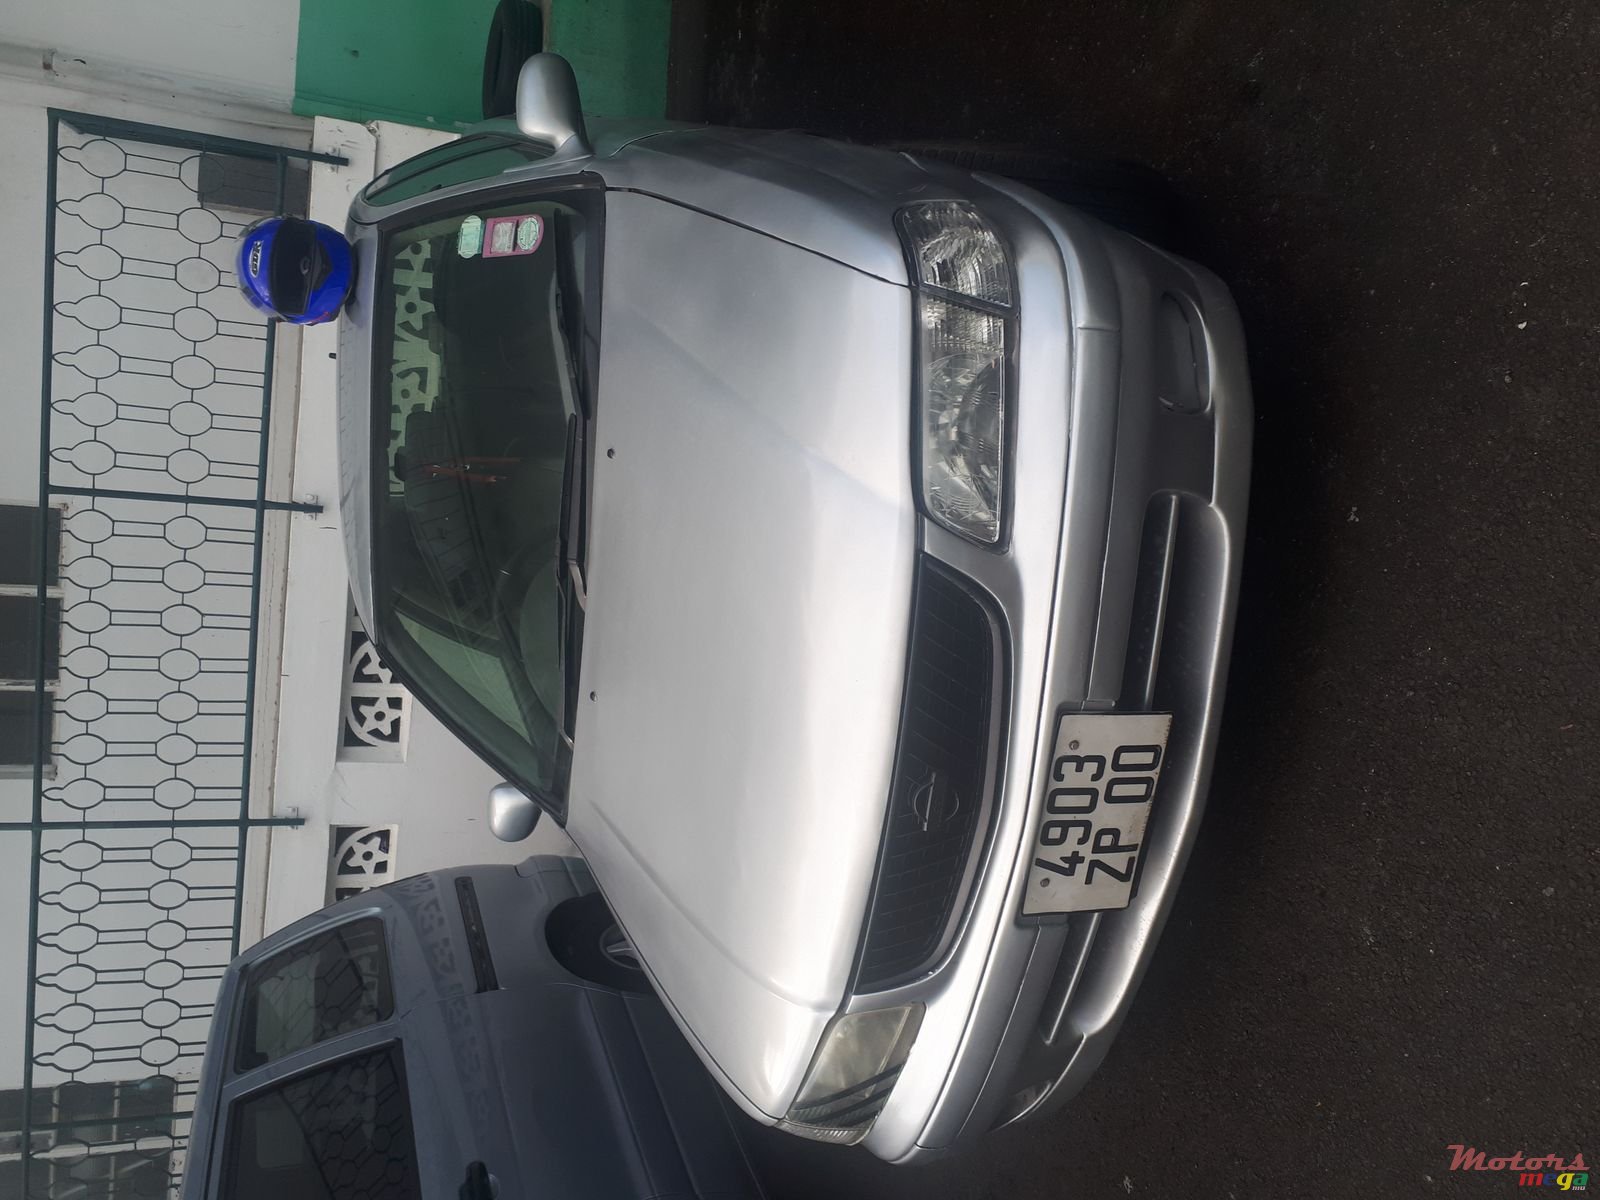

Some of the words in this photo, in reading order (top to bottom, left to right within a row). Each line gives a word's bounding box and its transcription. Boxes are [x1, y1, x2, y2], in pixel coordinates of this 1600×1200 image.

[1103, 744, 1163, 804] 00
[1035, 754, 1107, 877] 4903
[1084, 827, 1140, 886] ZP
